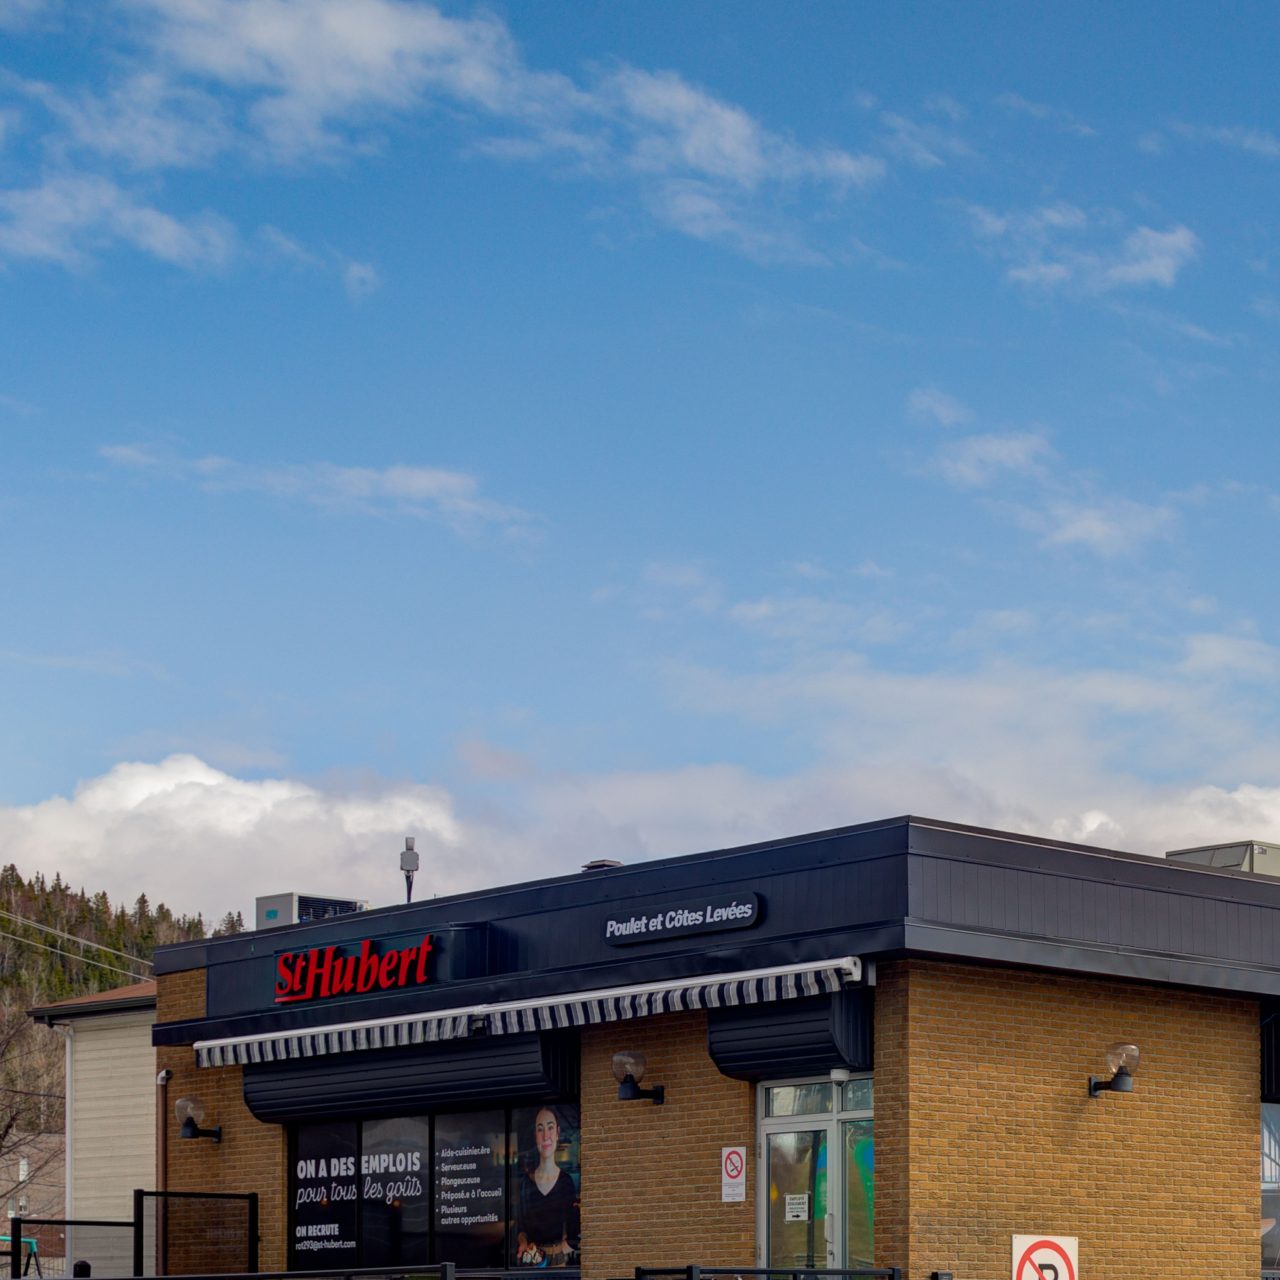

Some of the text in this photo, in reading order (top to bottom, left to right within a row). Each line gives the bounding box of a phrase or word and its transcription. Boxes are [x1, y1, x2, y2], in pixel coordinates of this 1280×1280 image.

[606, 901, 752, 938] Poulet et Côtes Levées
[297, 1152, 421, 1179] ON A DES EMPLOIS
[295, 1175, 422, 1210] pour tous les goûts
[471, 1189, 476, 1198] à
[441, 1213, 499, 1225] autres opportunités
[296, 1223, 340, 1237] ON RECRUTE
